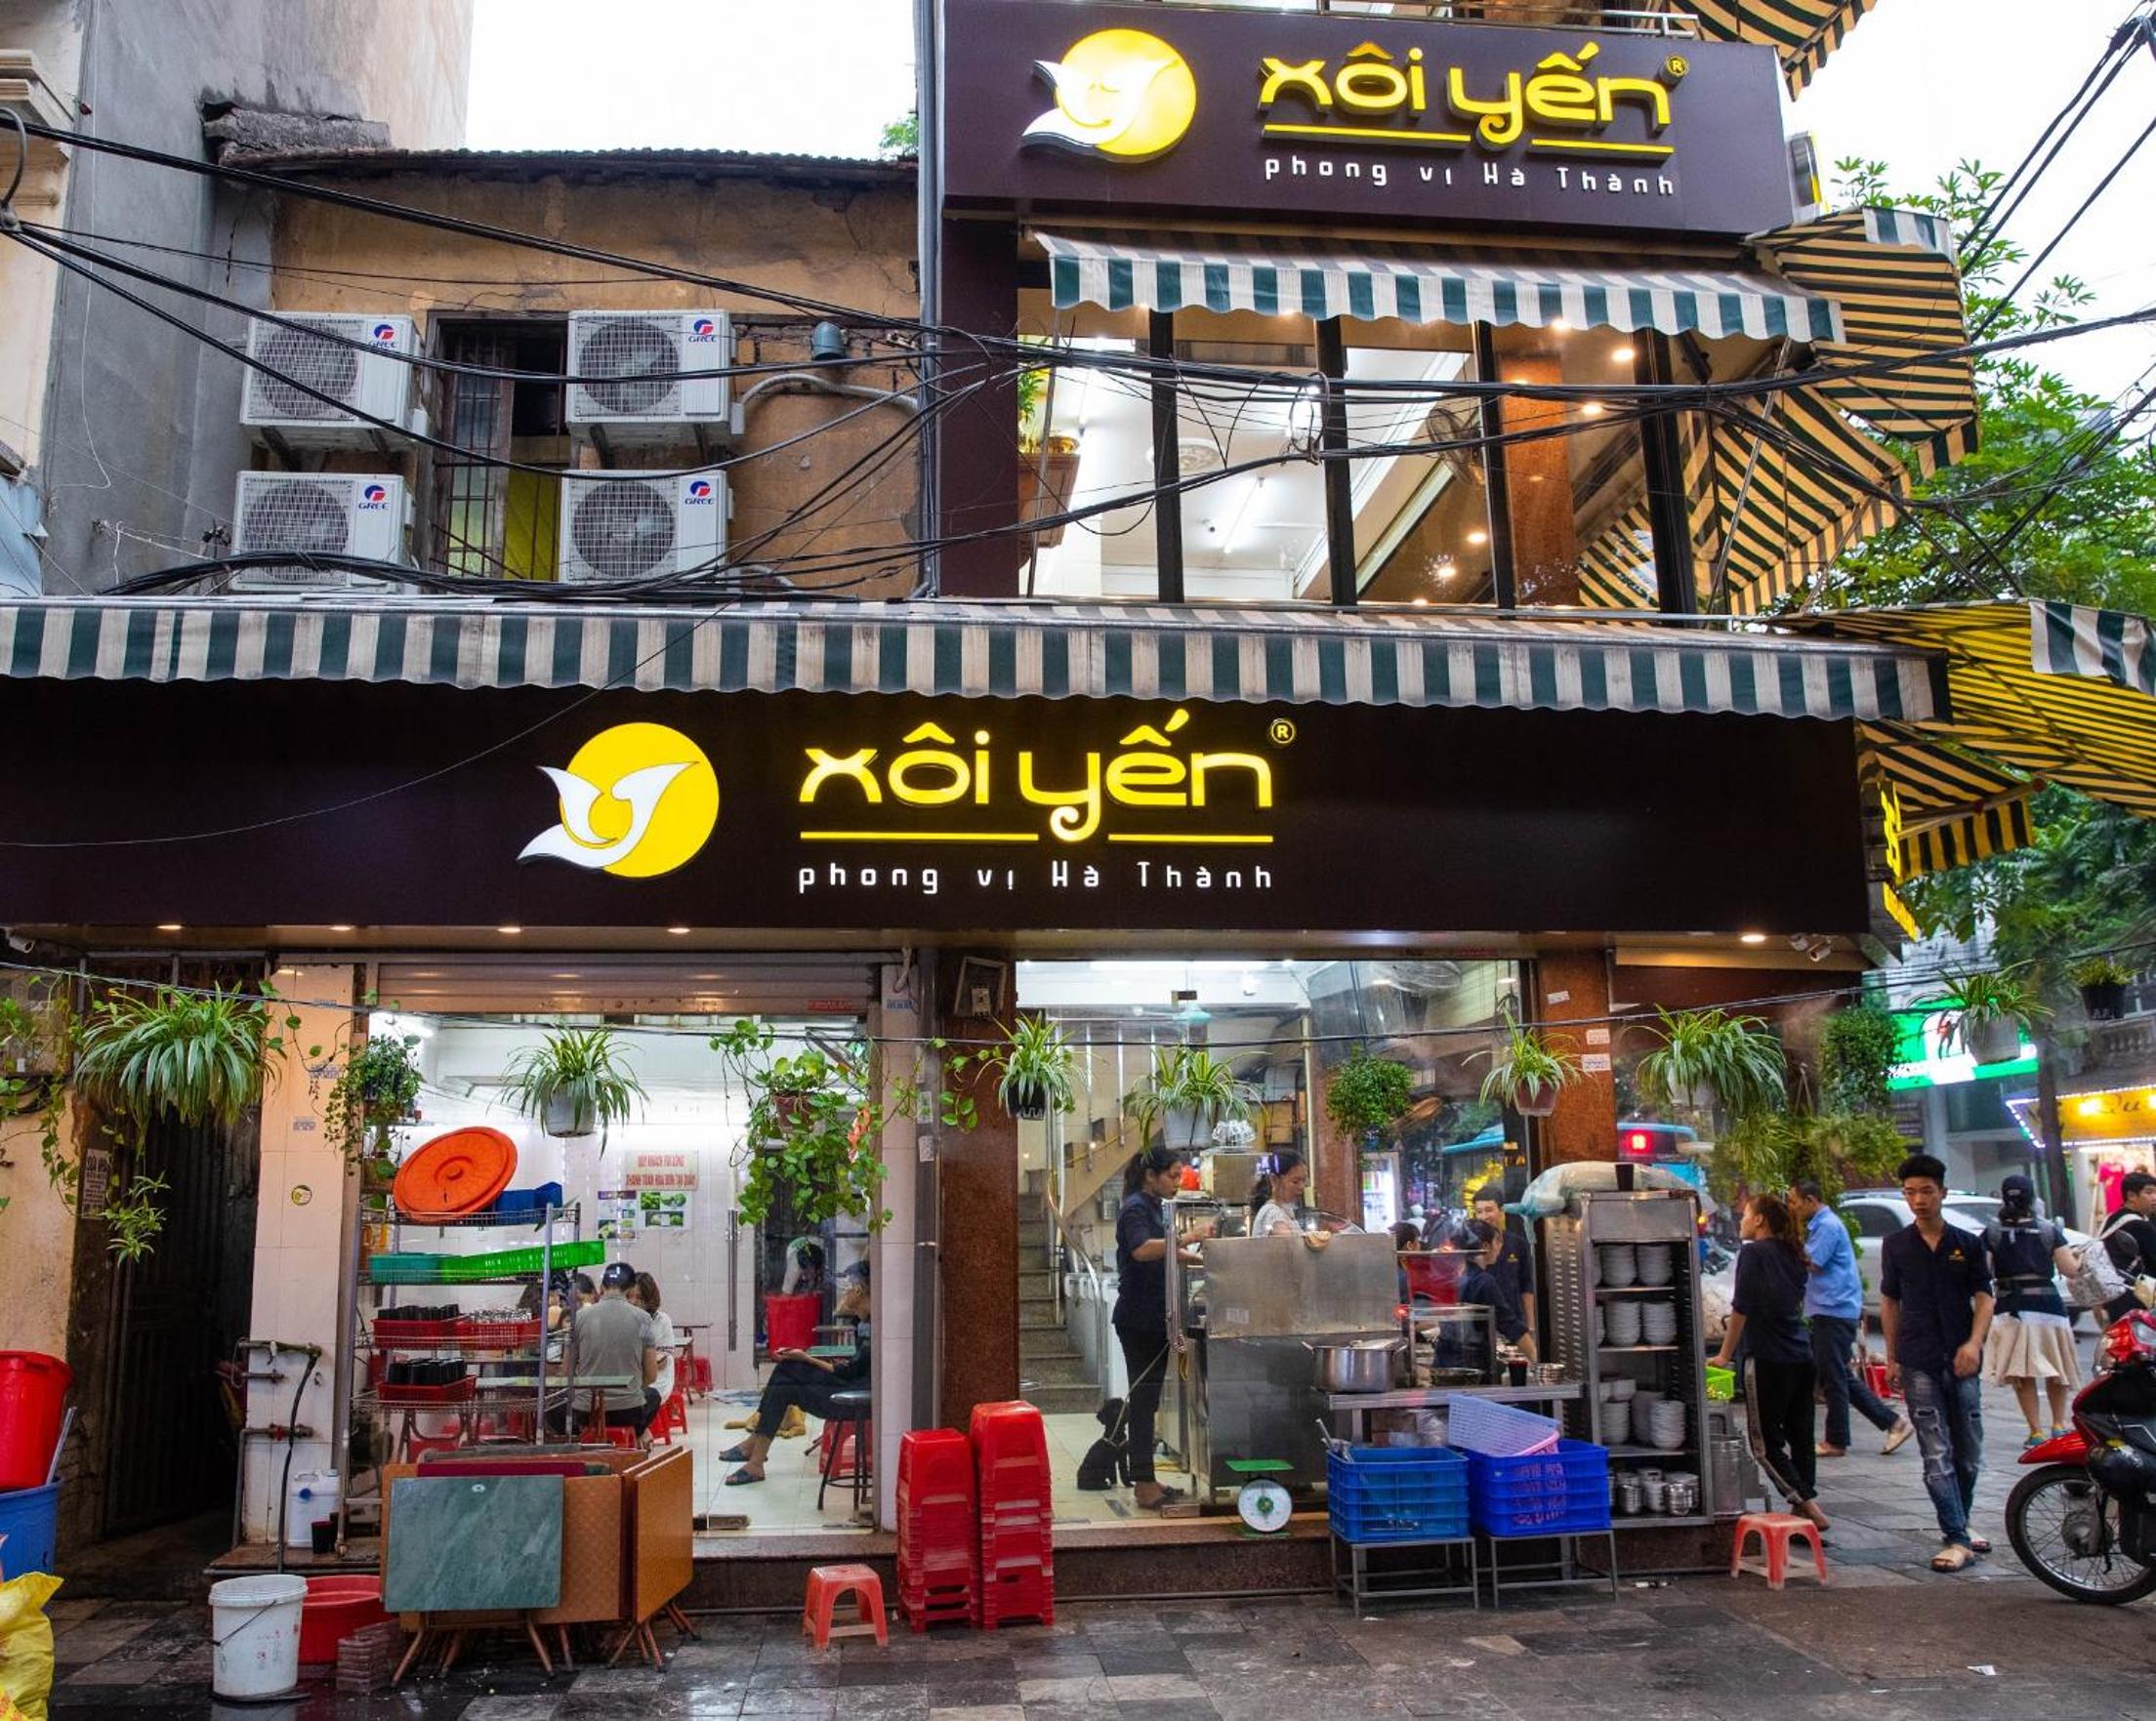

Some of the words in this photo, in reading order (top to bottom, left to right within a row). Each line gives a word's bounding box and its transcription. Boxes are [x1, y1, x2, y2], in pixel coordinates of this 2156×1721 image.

[1265, 155, 1388, 186] phong
[1483, 162, 1525, 186] Hà
[1556, 167, 1675, 194] Thành
[799, 862, 938, 895] phong
[976, 869, 1014, 890] vị
[1052, 860, 1099, 887] Hà
[1137, 861, 1271, 888] Thành
